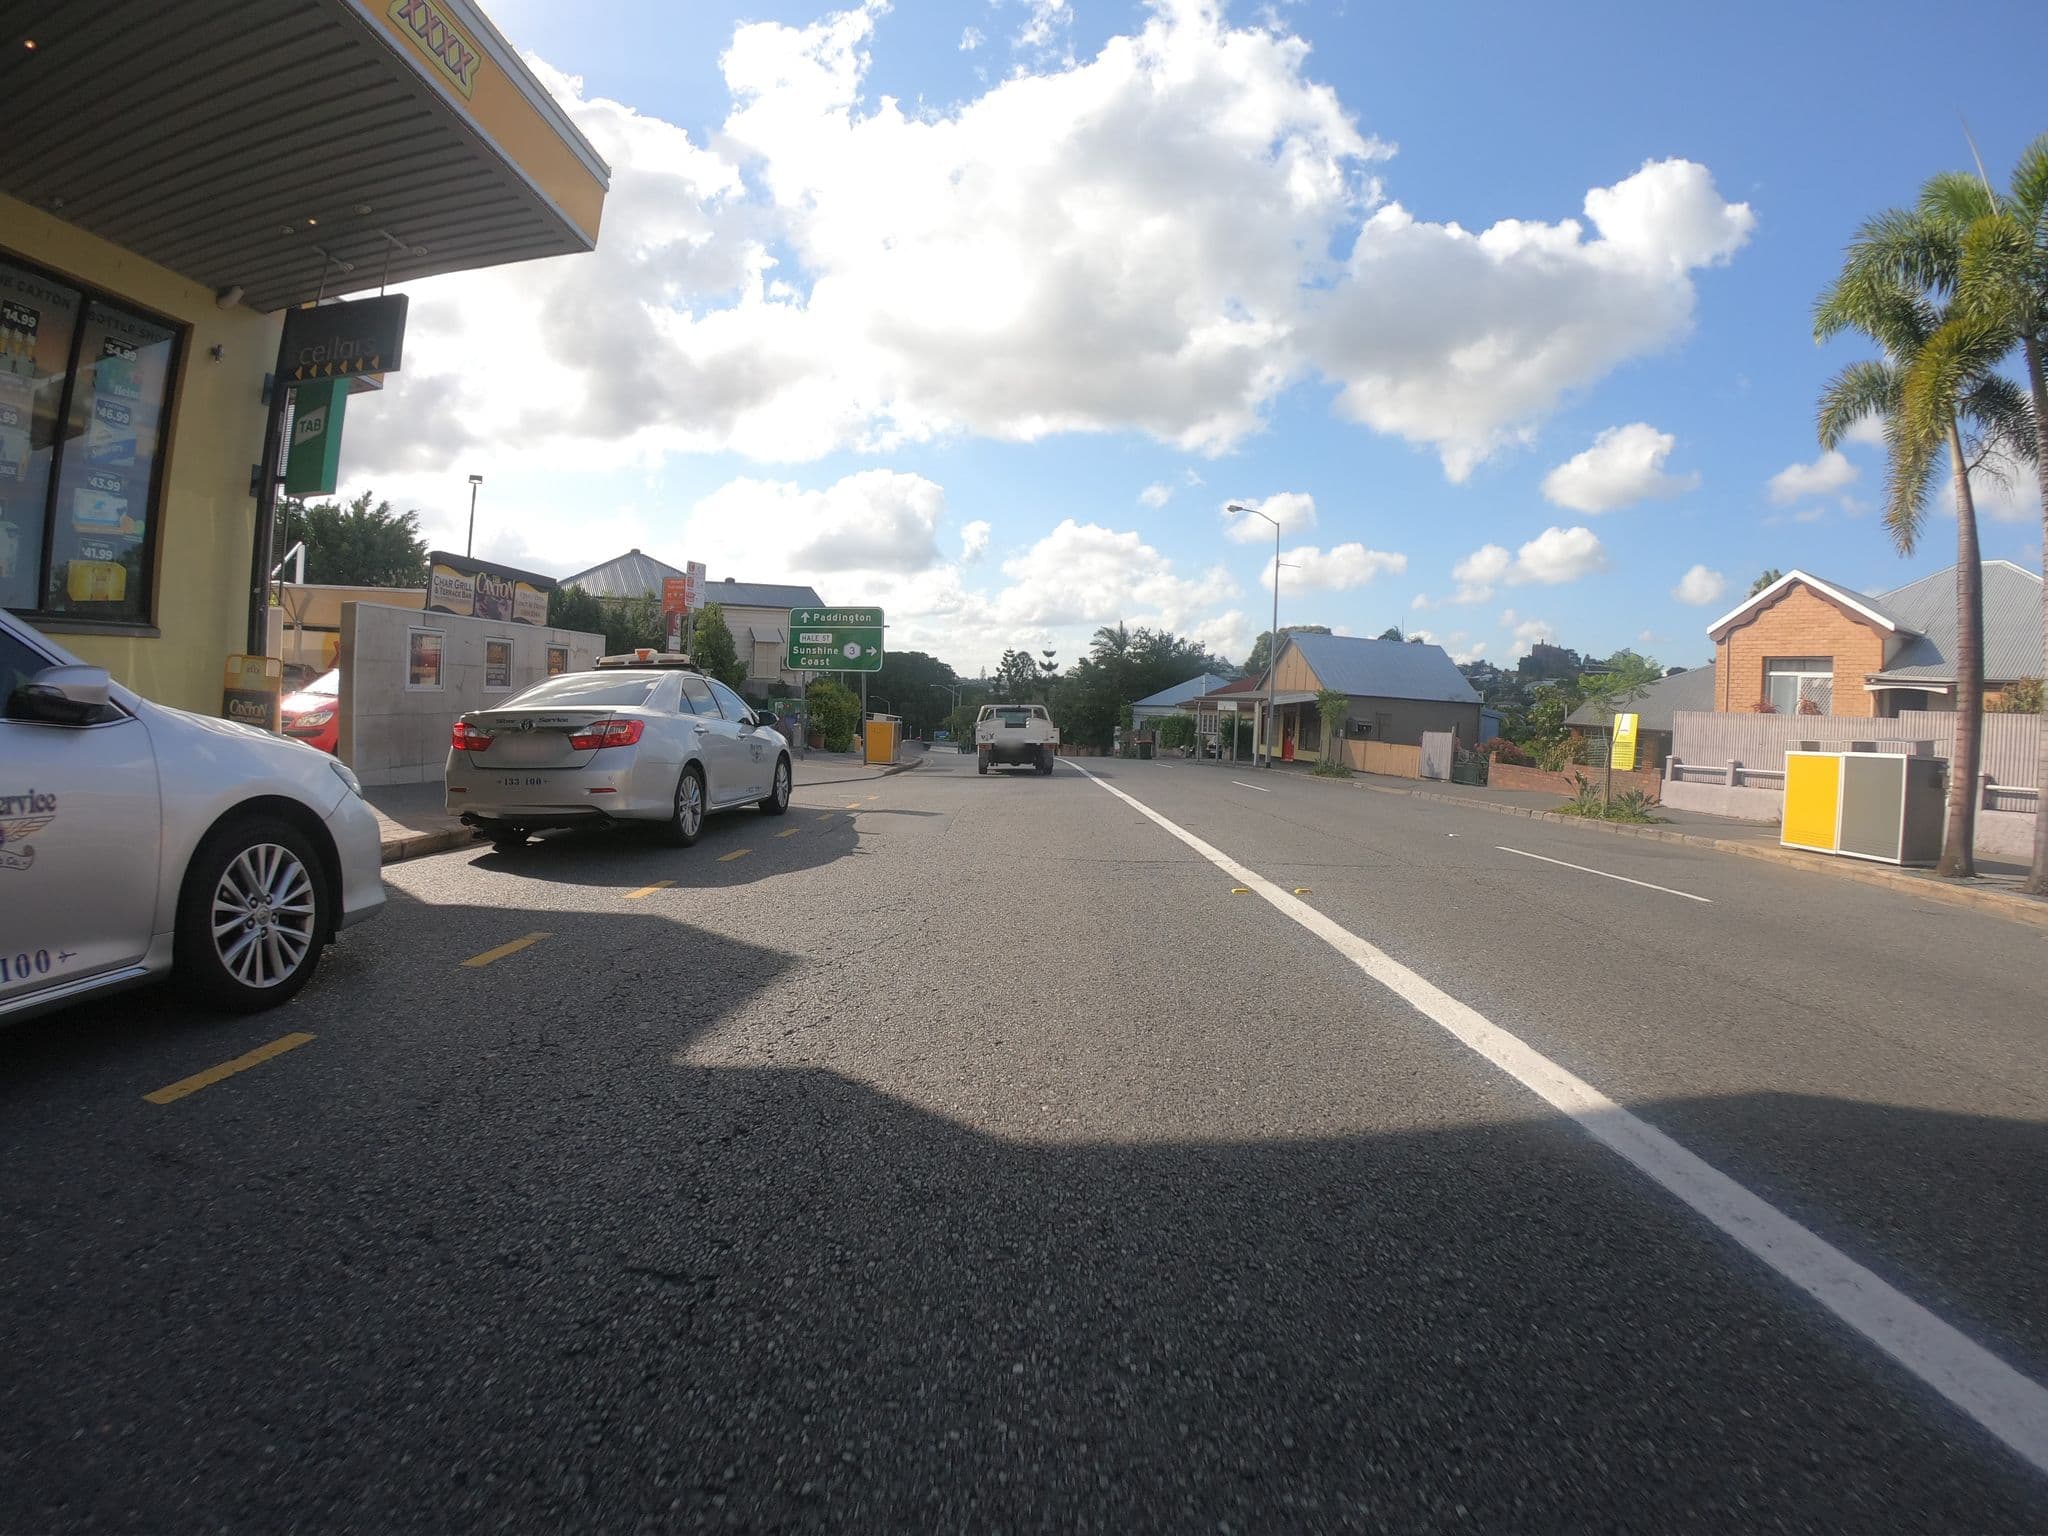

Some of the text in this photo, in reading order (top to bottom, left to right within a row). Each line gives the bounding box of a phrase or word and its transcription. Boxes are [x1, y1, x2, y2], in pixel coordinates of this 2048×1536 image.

[398, 0, 474, 87] XXXX
[299, 418, 322, 433] TAB
[434, 576, 472, 591] CHAR GRILL
[813, 613, 871, 625] Paddington
[792, 646, 839, 655] Sunshine
[848, 646, 856, 656] 3
[800, 657, 830, 666] Coast
[504, 777, 542, 786] 133 100
[0, 948, 51, 983] 100
